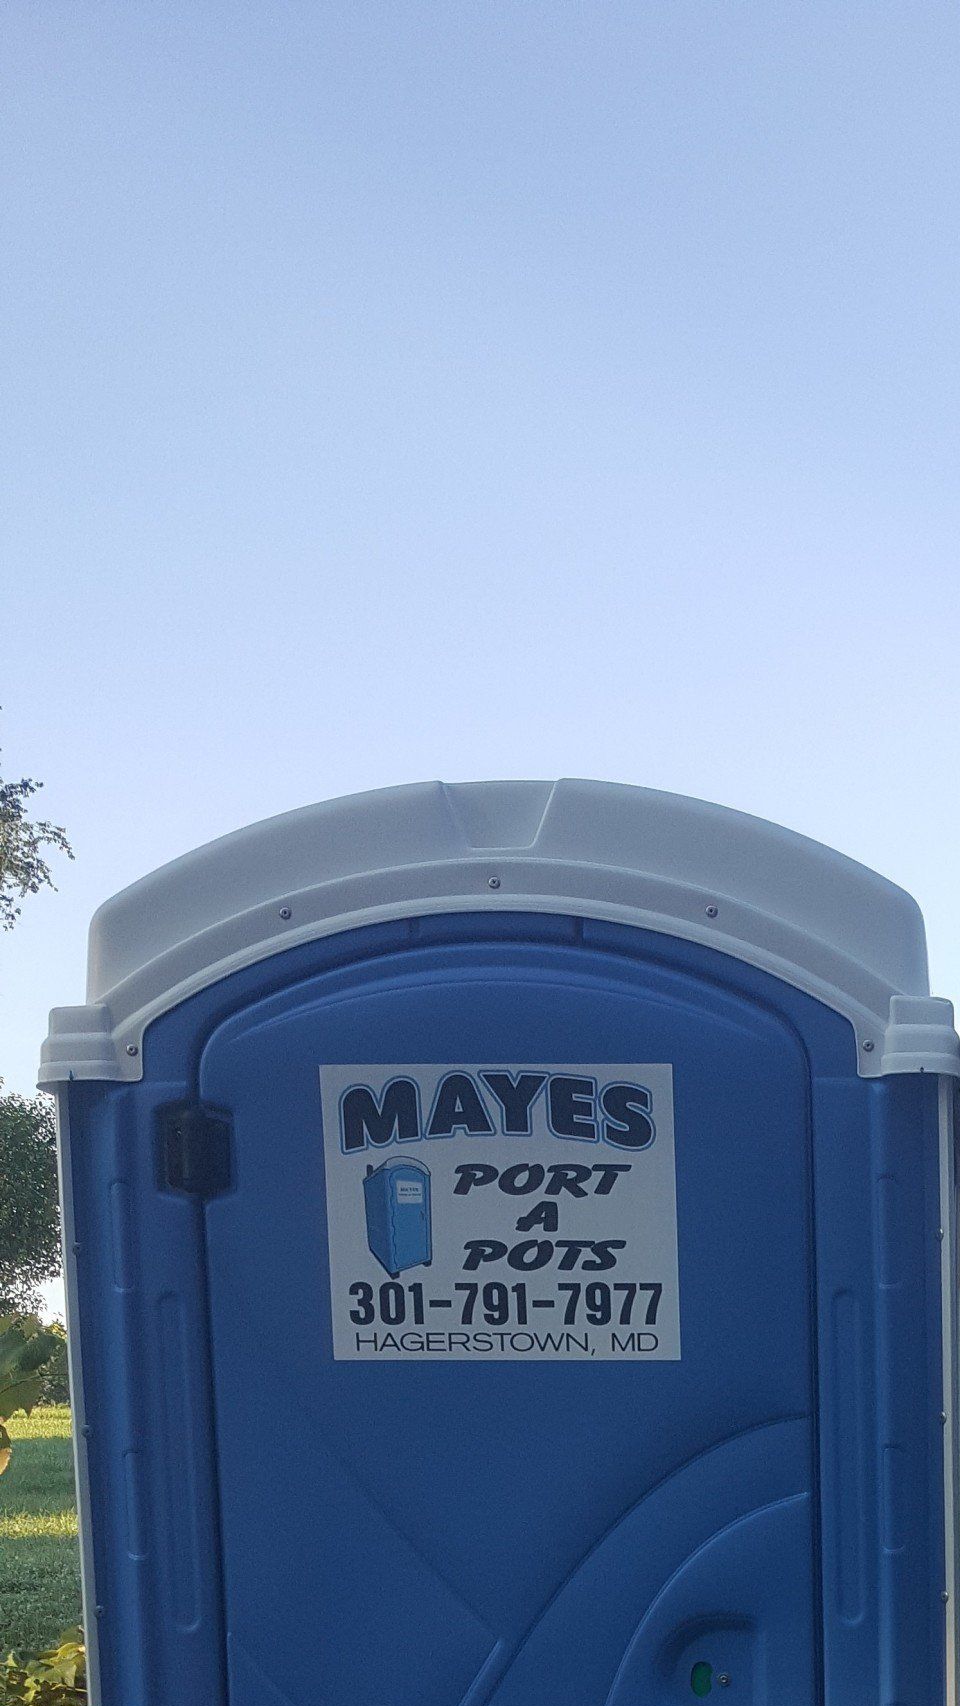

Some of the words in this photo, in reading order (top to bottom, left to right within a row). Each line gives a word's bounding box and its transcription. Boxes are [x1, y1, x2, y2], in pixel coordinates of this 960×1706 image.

[339, 1070, 656, 1155] MAYES
[453, 1163, 631, 1198] PORT
[515, 1200, 559, 1232] A
[462, 1239, 626, 1272] POTS
[349, 1281, 663, 1326] 301-791-7977
[356, 1332, 596, 1355] HAGERSTOWN,
[611, 1332, 658, 1352] MD
